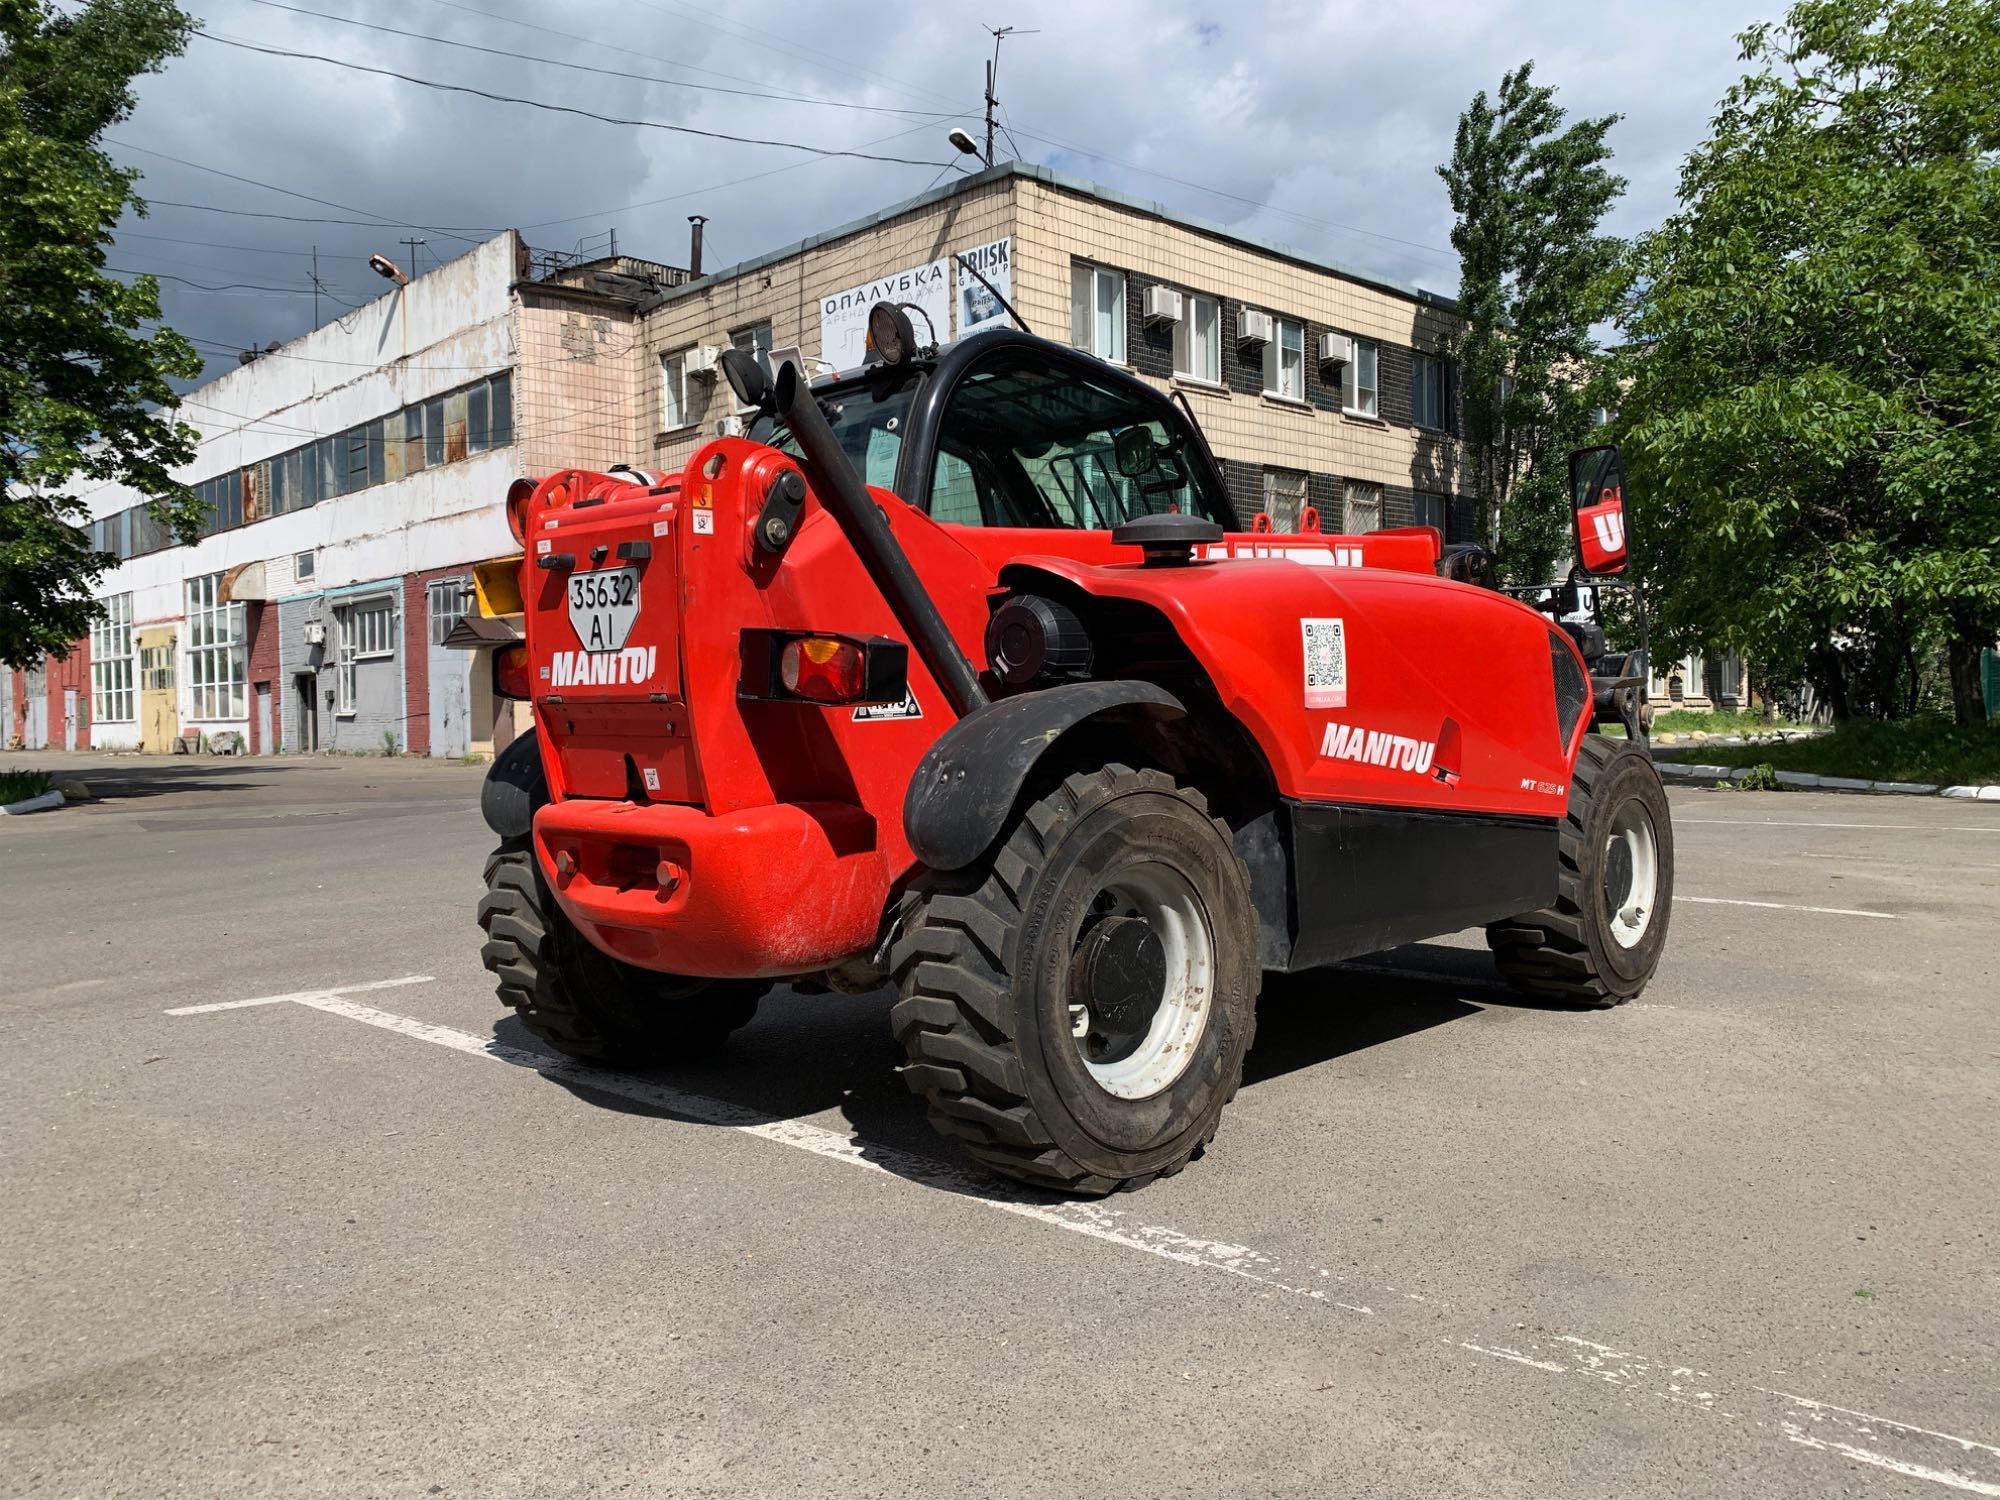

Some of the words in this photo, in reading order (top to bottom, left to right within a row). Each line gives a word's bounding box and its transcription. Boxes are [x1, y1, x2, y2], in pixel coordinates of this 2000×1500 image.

[958, 240, 1009, 277] PRIISK
[825, 265, 943, 315] ОПАЛУБКА
[888, 282, 943, 304] РОДАЖА
[574, 574, 634, 610] 35632
[1320, 722, 1435, 774] MANITOU
[1520, 777, 1537, 791] MT
[1537, 780, 1556, 795] 625
[1556, 784, 1565, 796] H
